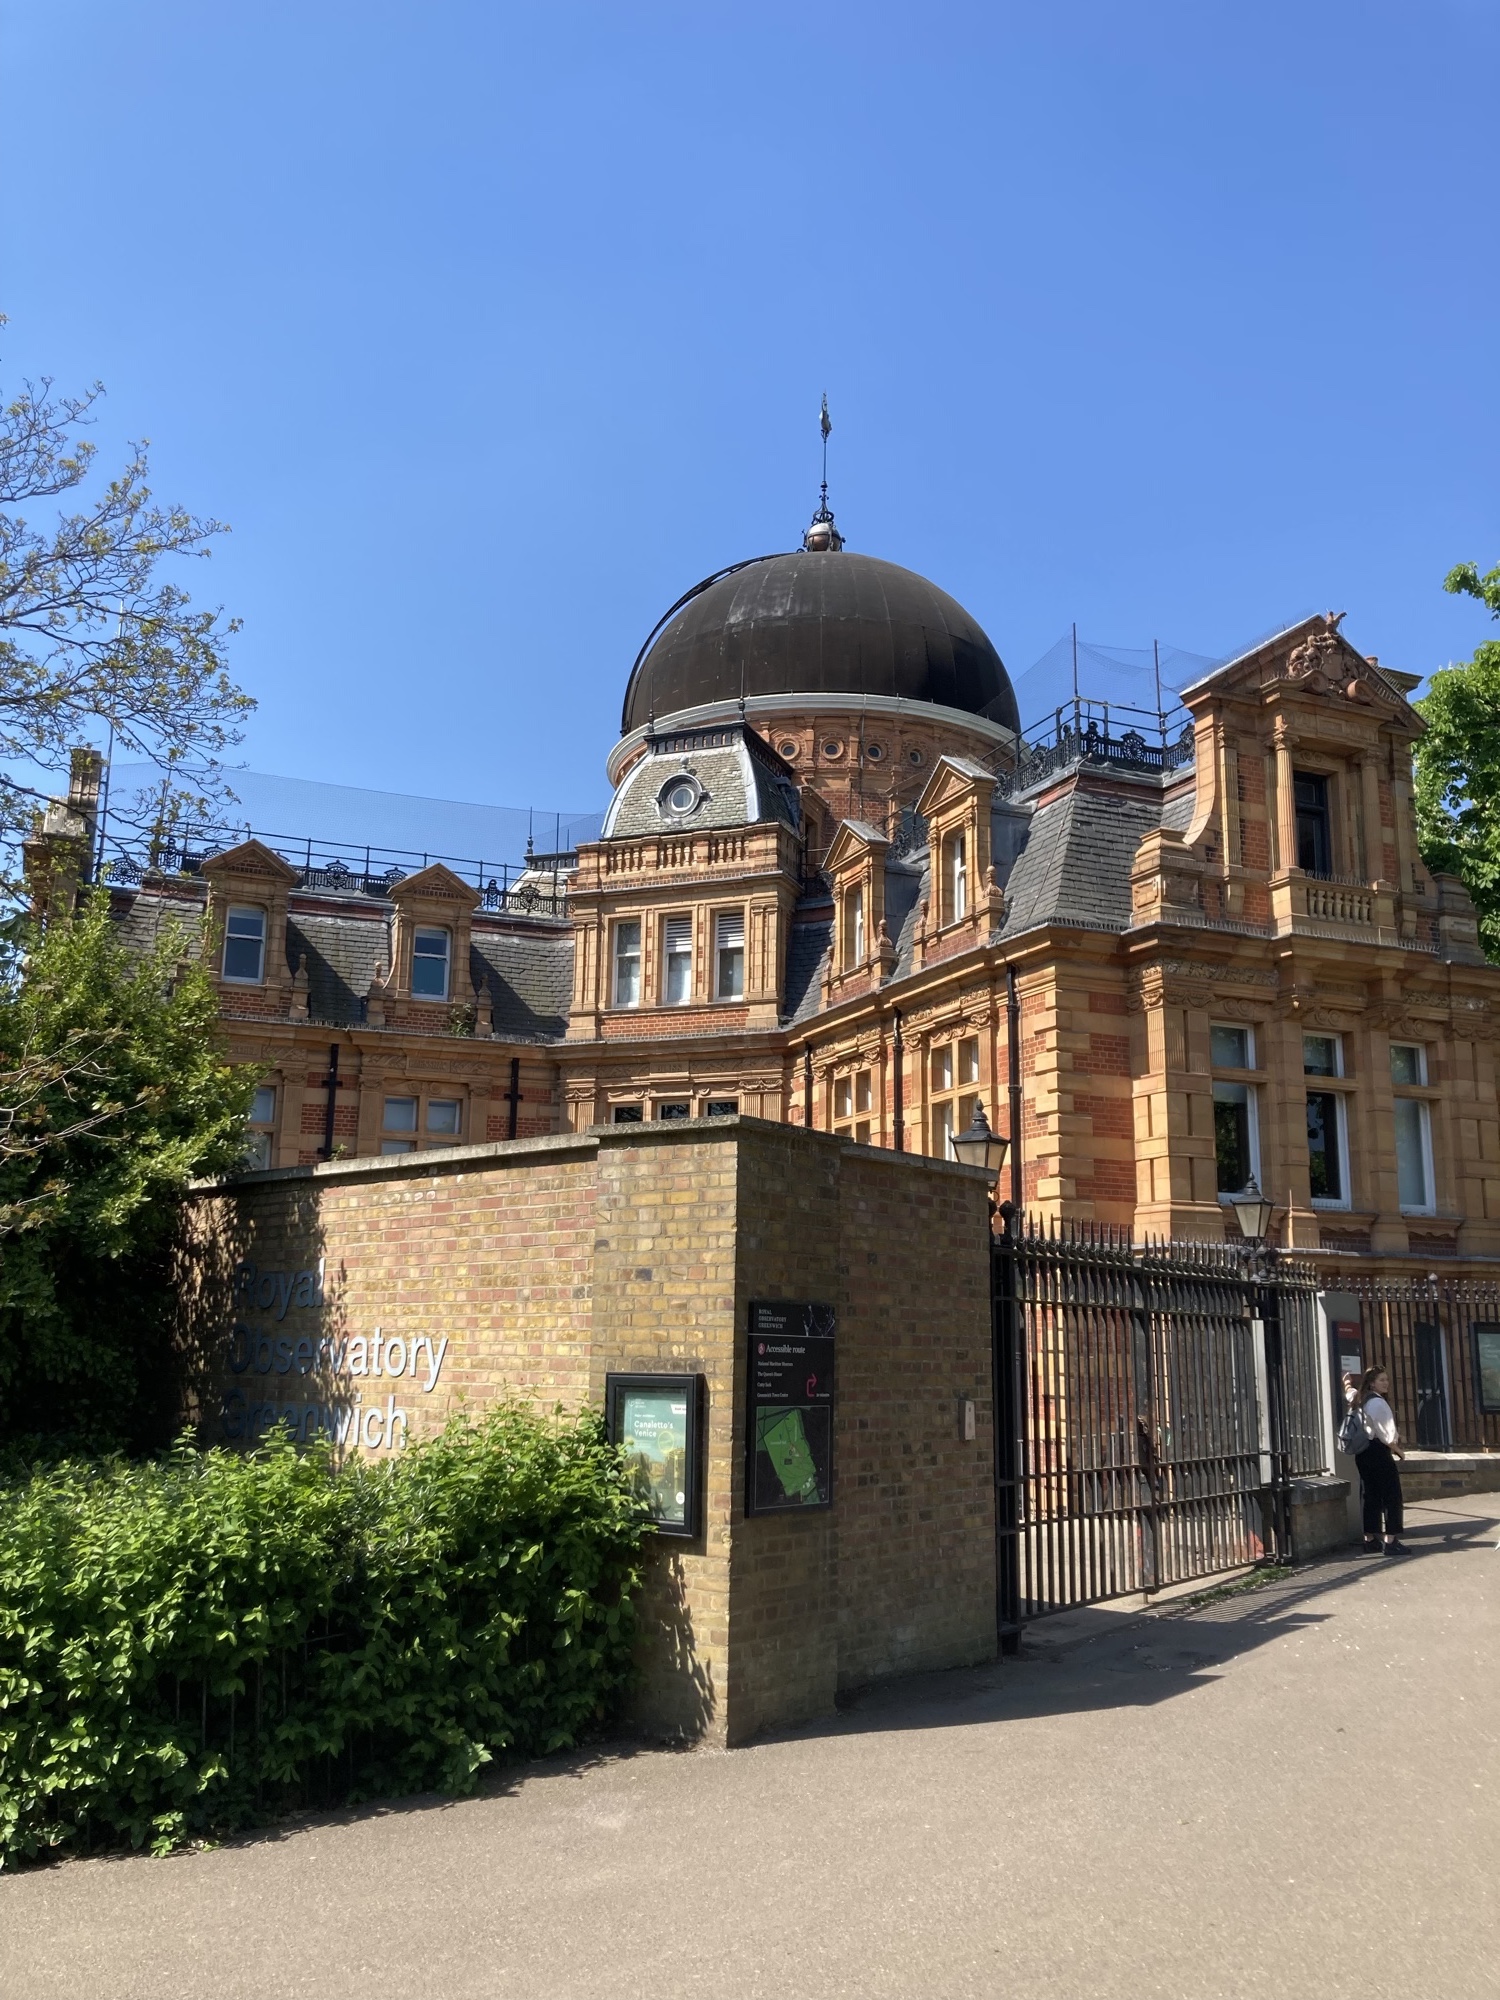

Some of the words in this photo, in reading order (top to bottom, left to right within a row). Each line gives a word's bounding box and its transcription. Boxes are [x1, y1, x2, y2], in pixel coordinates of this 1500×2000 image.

[233, 1257, 325, 1321] Royal
[229, 1323, 449, 1392] Observatory
[766, 1344, 792, 1354] Accessible
[792, 1346, 806, 1354] route
[222, 1388, 408, 1449] Greenwich
[634, 1420, 674, 1429] Canaletto's
[634, 1429, 657, 1437] Venice
